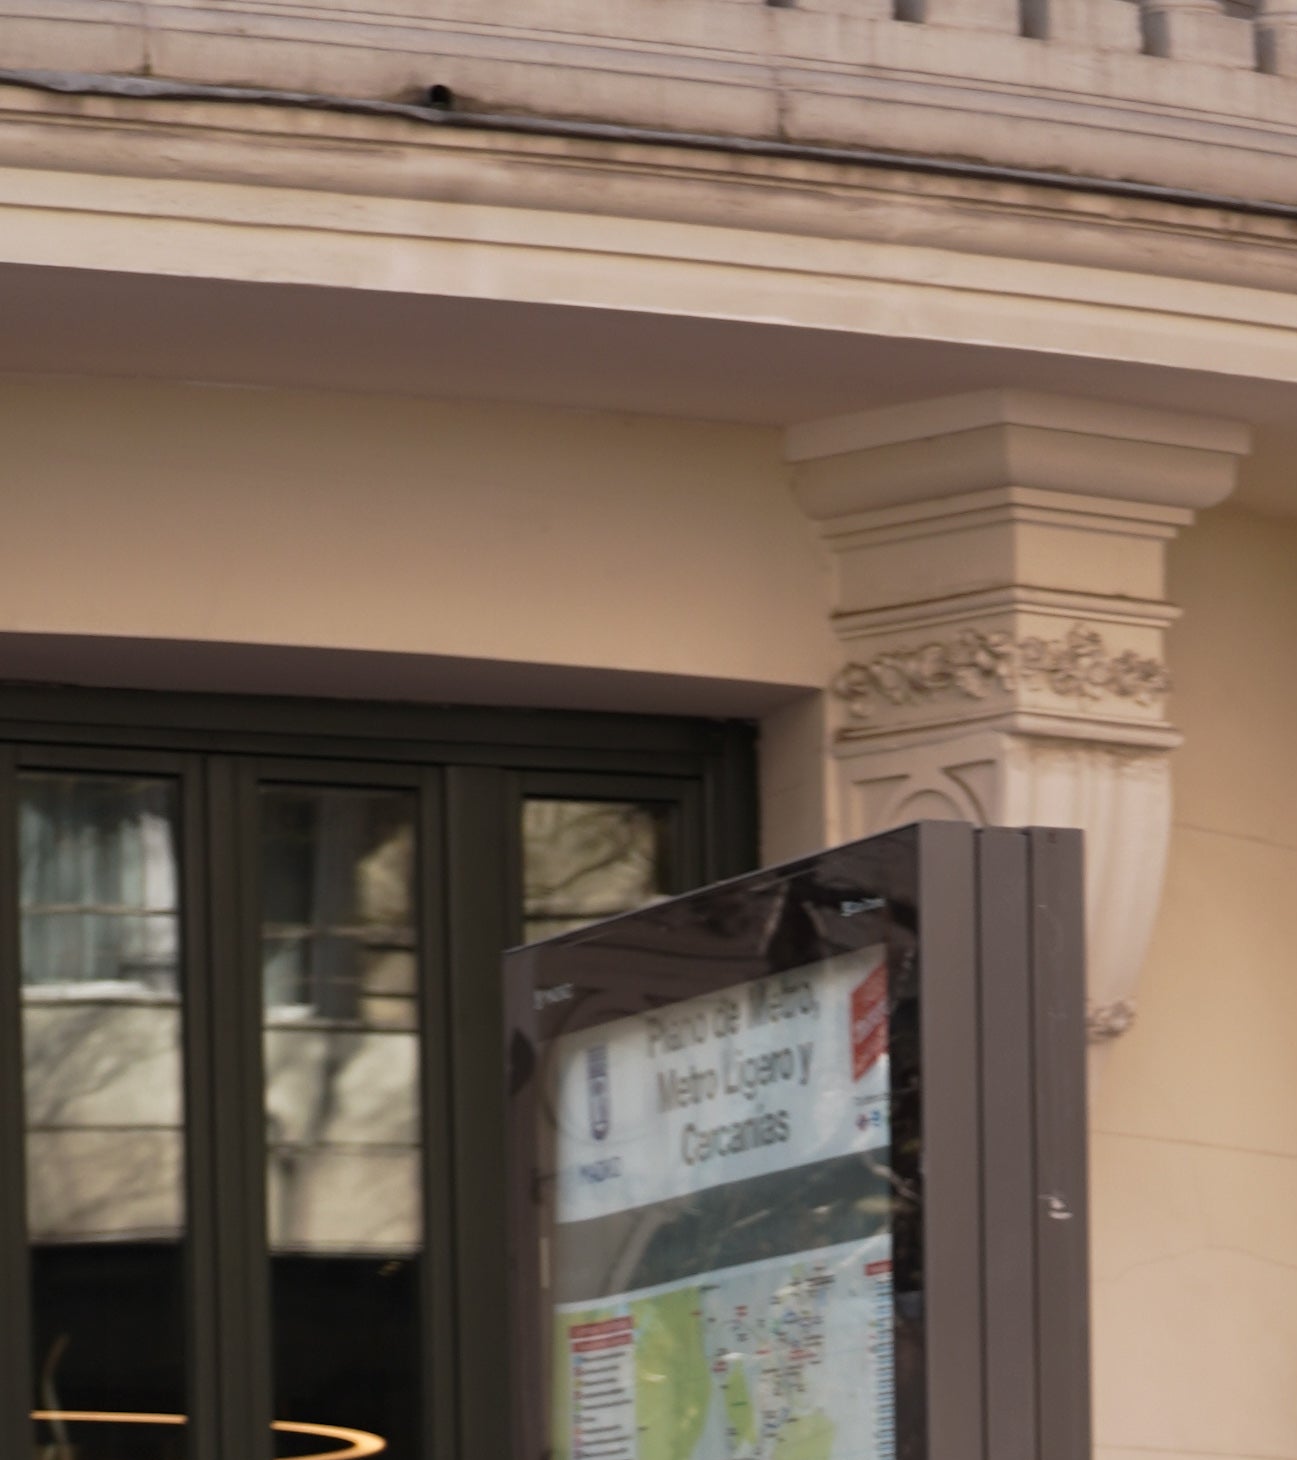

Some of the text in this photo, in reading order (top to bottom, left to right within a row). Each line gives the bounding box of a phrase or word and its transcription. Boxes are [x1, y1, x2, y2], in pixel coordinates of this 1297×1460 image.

[647, 1008, 709, 1058] Plano
[713, 993, 742, 1039] de
[656, 1041, 815, 1114] Metro Ligero y
